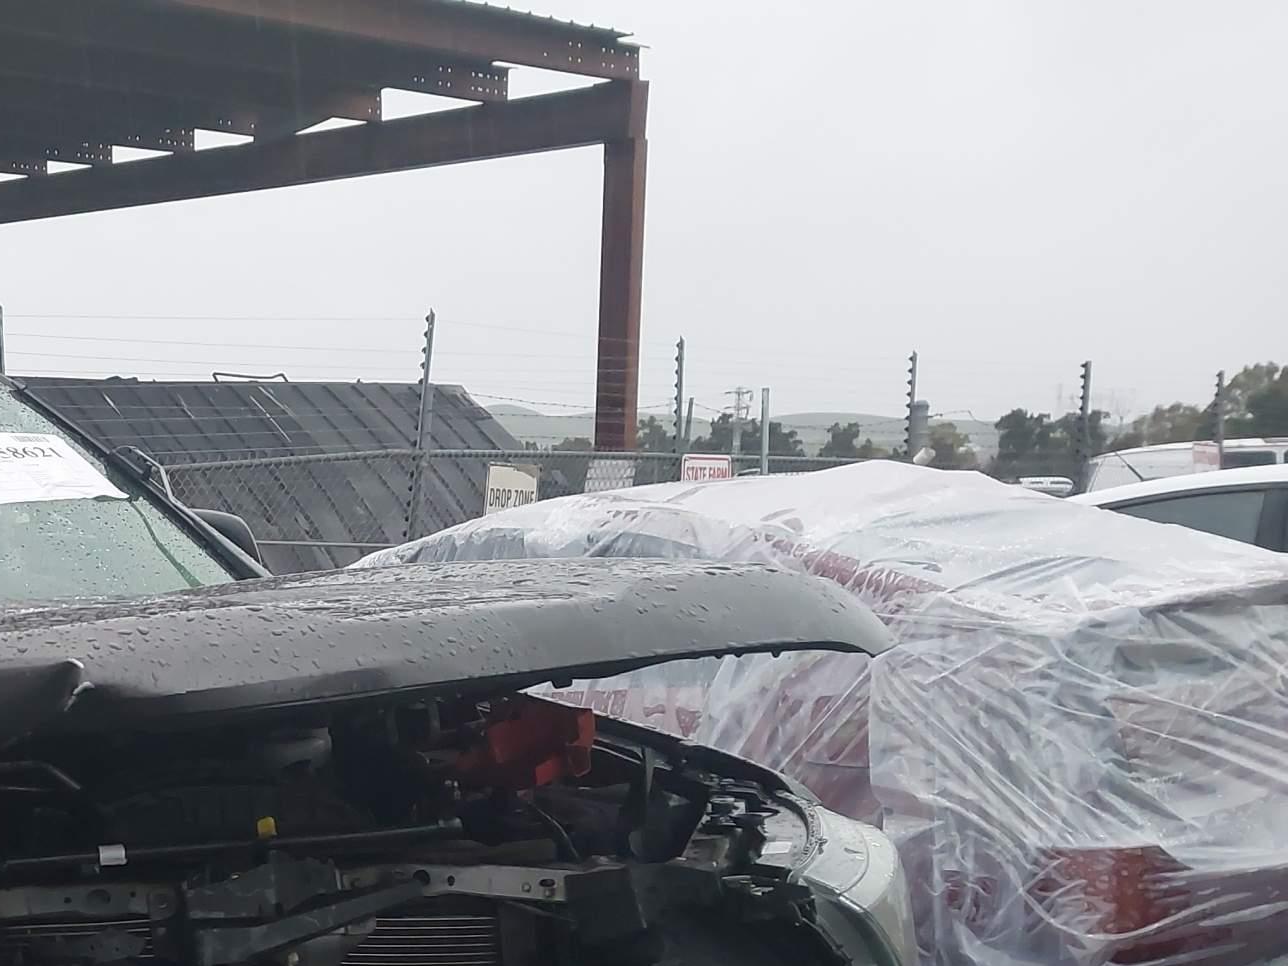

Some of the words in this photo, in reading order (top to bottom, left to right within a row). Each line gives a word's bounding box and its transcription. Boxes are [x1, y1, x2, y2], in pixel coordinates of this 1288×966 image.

[685, 466, 707, 481] STATE
[488, 488, 512, 508] DROP
[513, 489, 535, 508] ZONE
